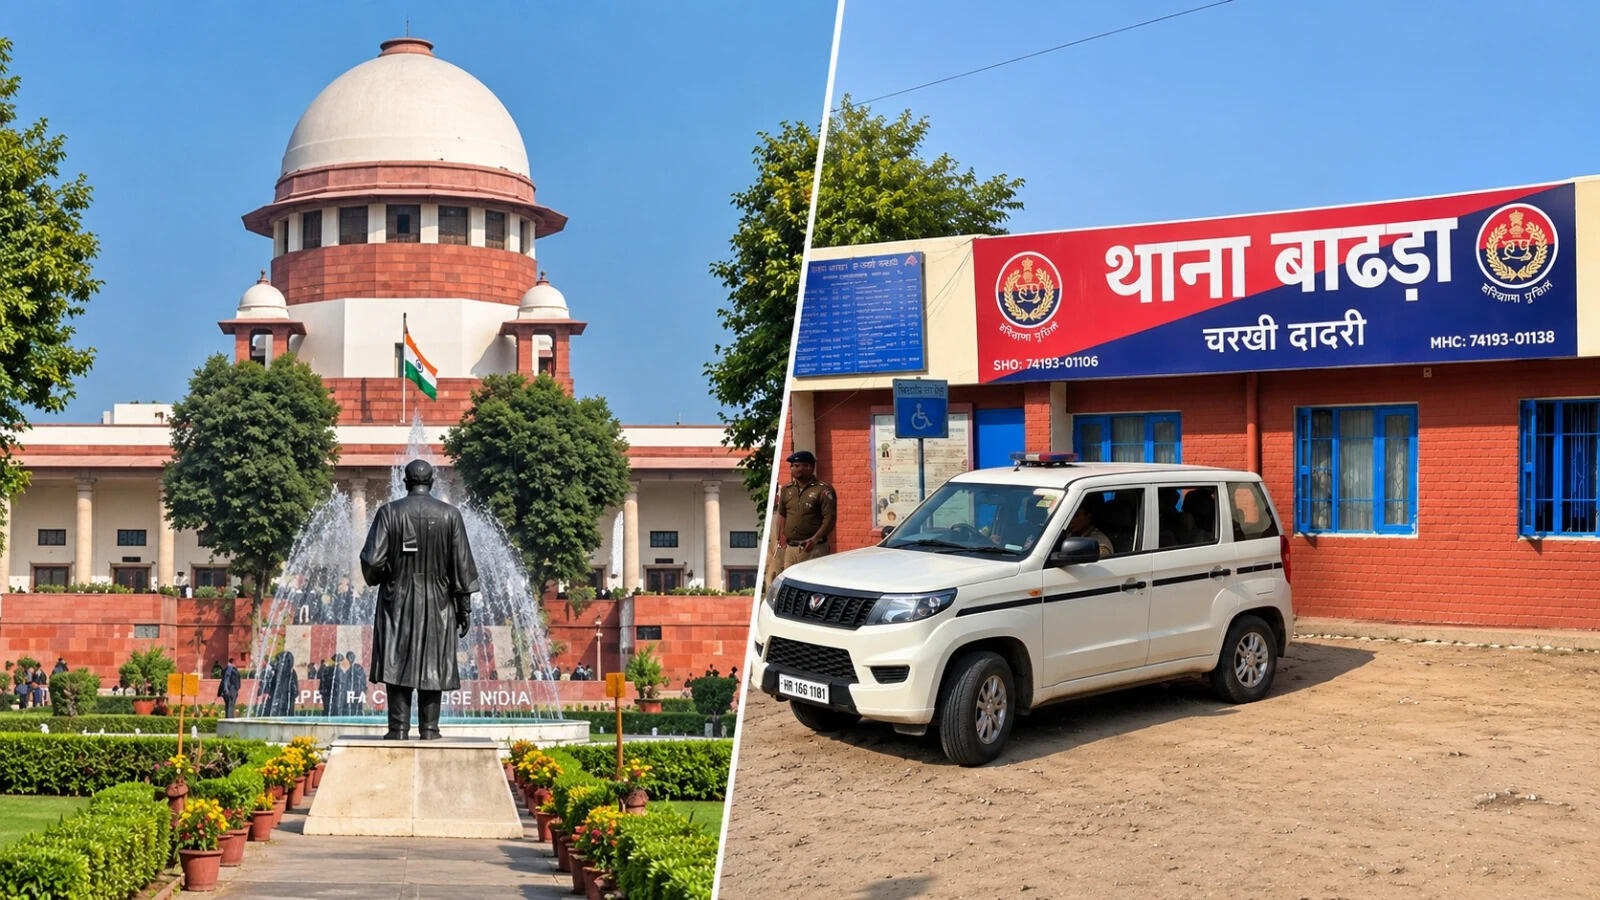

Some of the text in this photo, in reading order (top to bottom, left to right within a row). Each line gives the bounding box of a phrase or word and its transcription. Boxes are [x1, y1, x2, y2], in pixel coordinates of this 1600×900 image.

[1104, 217, 1458, 303] थाना बाढड़ा
[1203, 308, 1367, 353] चरखी दादरी
[1430, 330, 1555, 349] MHC: 74193-01138
[993, 355, 1099, 371] SHO: 74193-01106
[784, 679, 793, 692] HR
